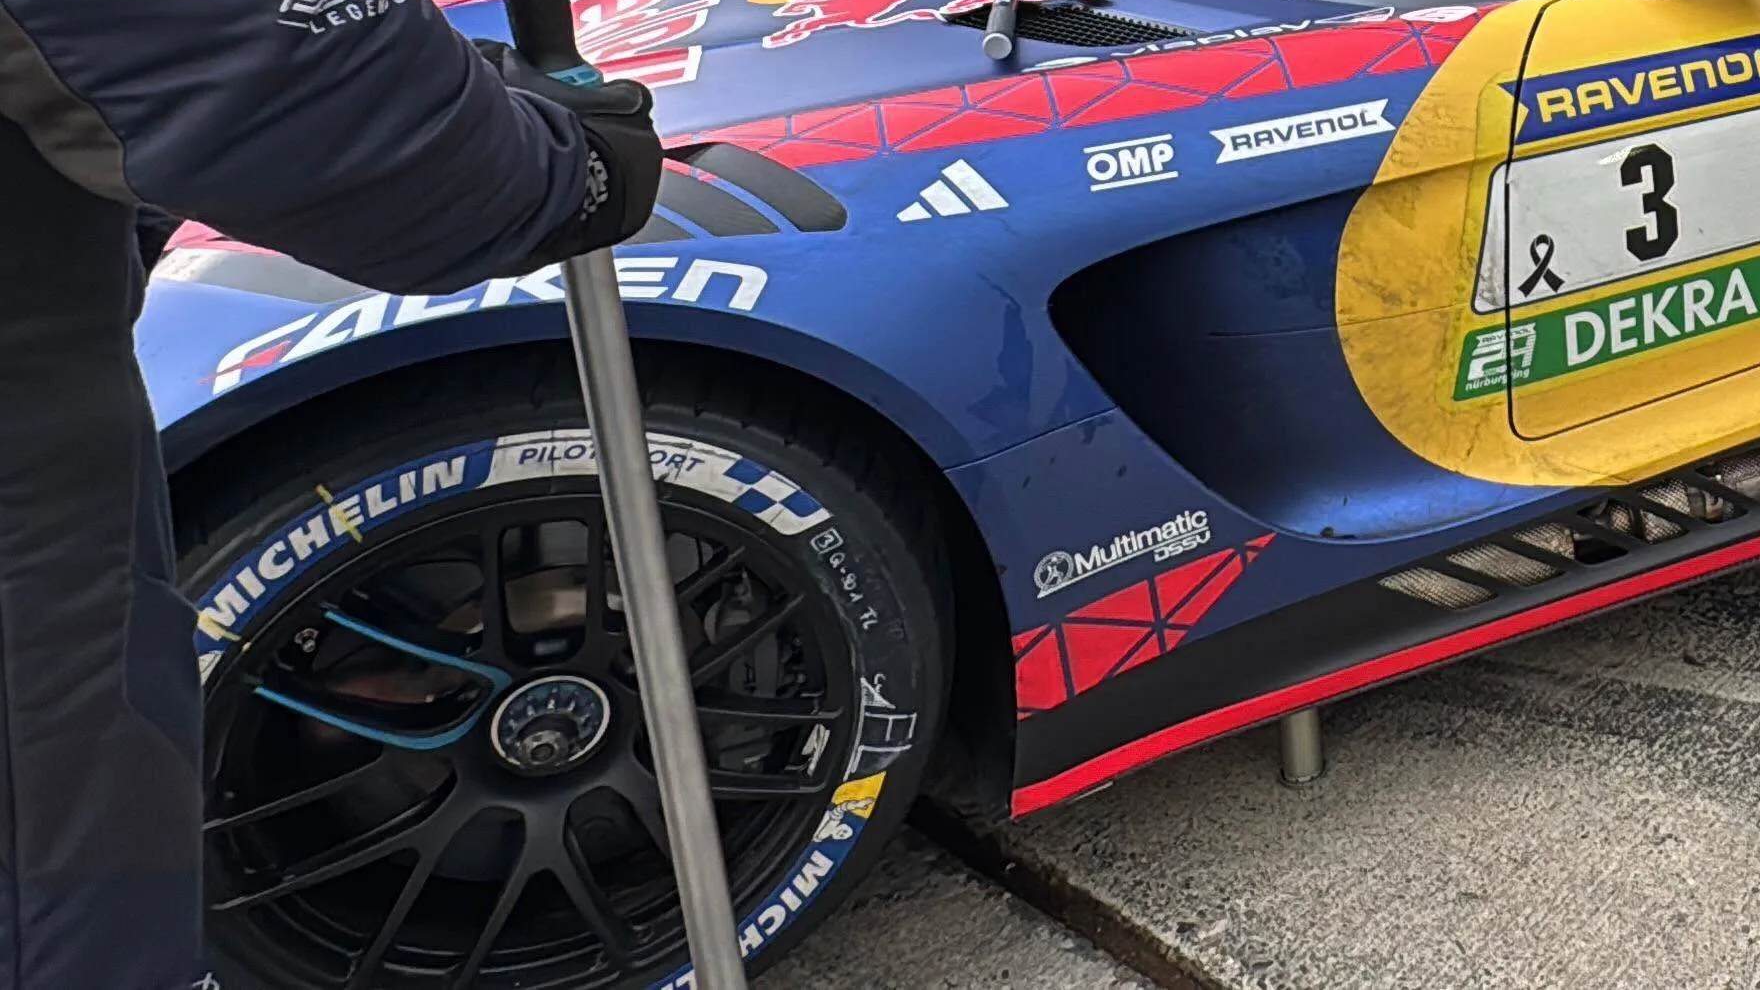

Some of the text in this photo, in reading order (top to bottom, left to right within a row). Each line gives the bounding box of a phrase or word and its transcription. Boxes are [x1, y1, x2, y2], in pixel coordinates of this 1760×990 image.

[1087, 141, 1175, 181] OMP
[1231, 109, 1376, 154] RAVENOL
[1619, 143, 1679, 262] 3
[1563, 268, 1759, 368] DEKRA
[197, 455, 466, 642] MICHELIN
[1074, 509, 1209, 575] Multimatic
[1154, 530, 1211, 562] DSSV
